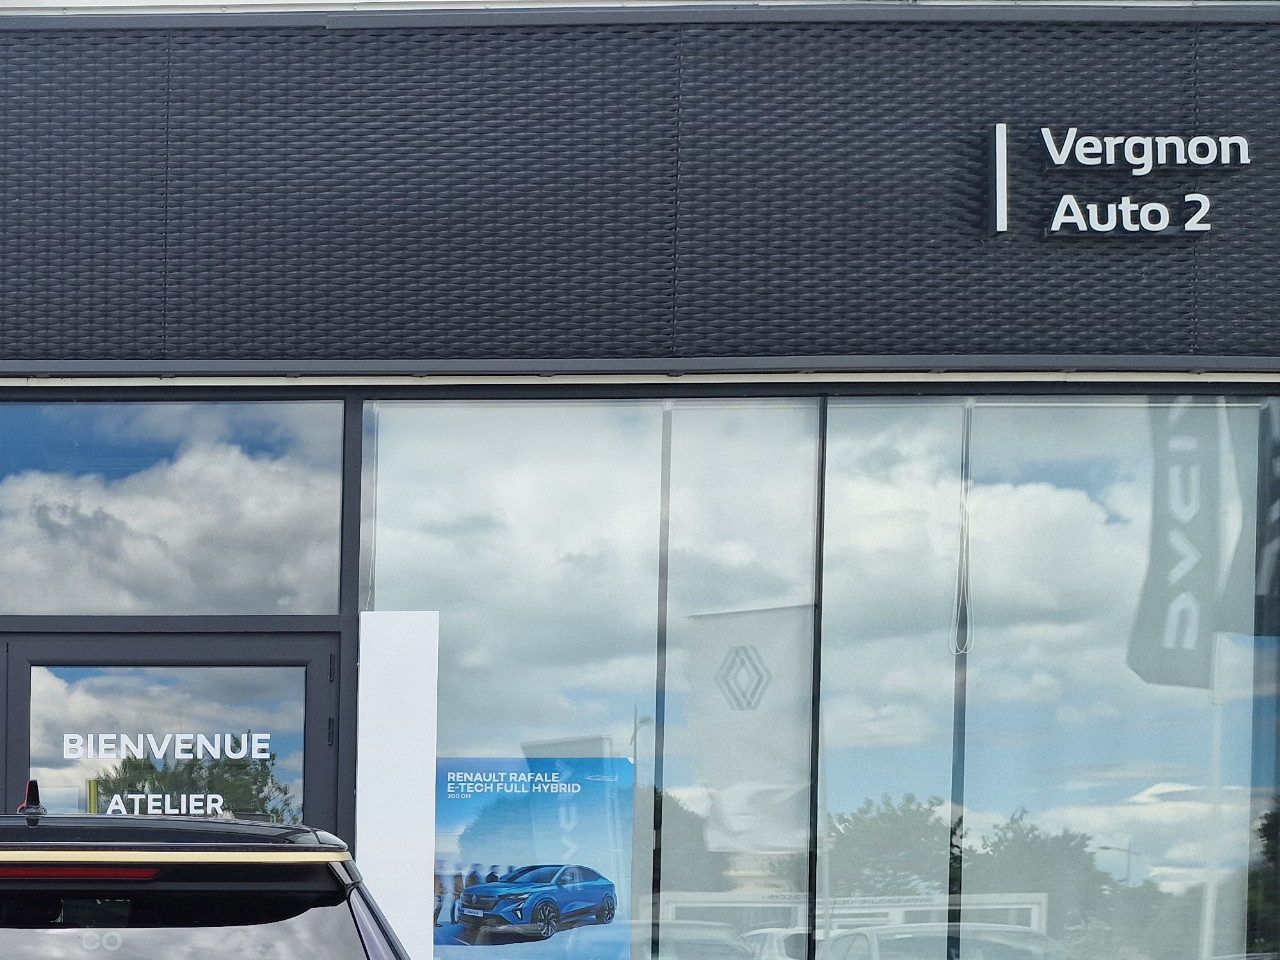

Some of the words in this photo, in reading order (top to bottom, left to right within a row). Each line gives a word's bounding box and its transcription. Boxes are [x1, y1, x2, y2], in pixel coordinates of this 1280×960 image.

[1040, 127, 1251, 176] Vergnon
[1050, 194, 1170, 232] Auto
[1183, 193, 1212, 232] 2
[63, 733, 271, 760] BIENVENUE
[447, 772, 507, 783] RENAULT
[509, 772, 560, 783] RAFALE
[447, 782, 494, 793] E-TECH
[496, 783, 529, 793] FULL
[532, 783, 581, 794] HYBRID
[106, 793, 225, 816] ATELIER
